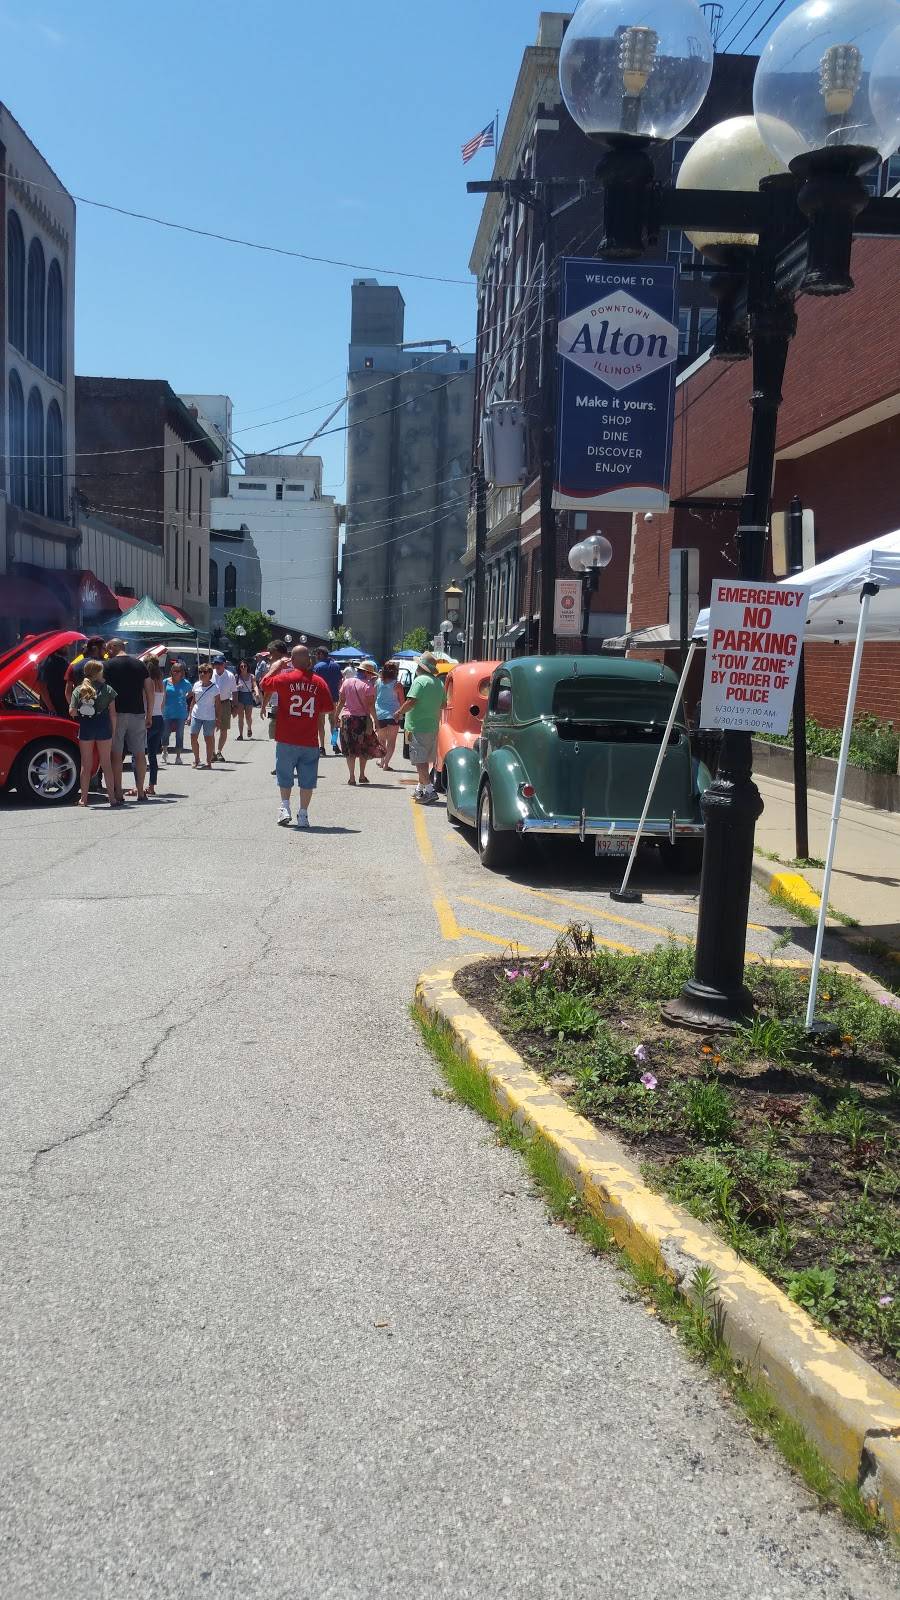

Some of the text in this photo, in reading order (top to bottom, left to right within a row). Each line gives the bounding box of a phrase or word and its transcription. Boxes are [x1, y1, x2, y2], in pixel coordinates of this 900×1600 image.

[585, 274, 654, 286] WELCOME TO
[590, 305, 650, 320] DOWNTOWN
[568, 320, 669, 358] Alton
[593, 360, 643, 375] ILLINOIS
[575, 396, 657, 412] Make it yours.
[601, 415, 632, 425] SHOP
[603, 431, 629, 442] DINE
[587, 446, 643, 458] DISCOVER
[595, 462, 632, 474] ENJOY
[717, 586, 804, 607] EMERGENCY
[742, 606, 772, 629] NO
[712, 629, 798, 656] PARKING
[711, 670, 790, 689] BY ORDER OF
[289, 682, 318, 695] ANKIEL
[725, 687, 770, 703] POLICE
[289, 695, 315, 718] 24
[715, 705, 776, 717] 6/30/19 7:00 AM
[713, 716, 743, 726] 6/30/19
